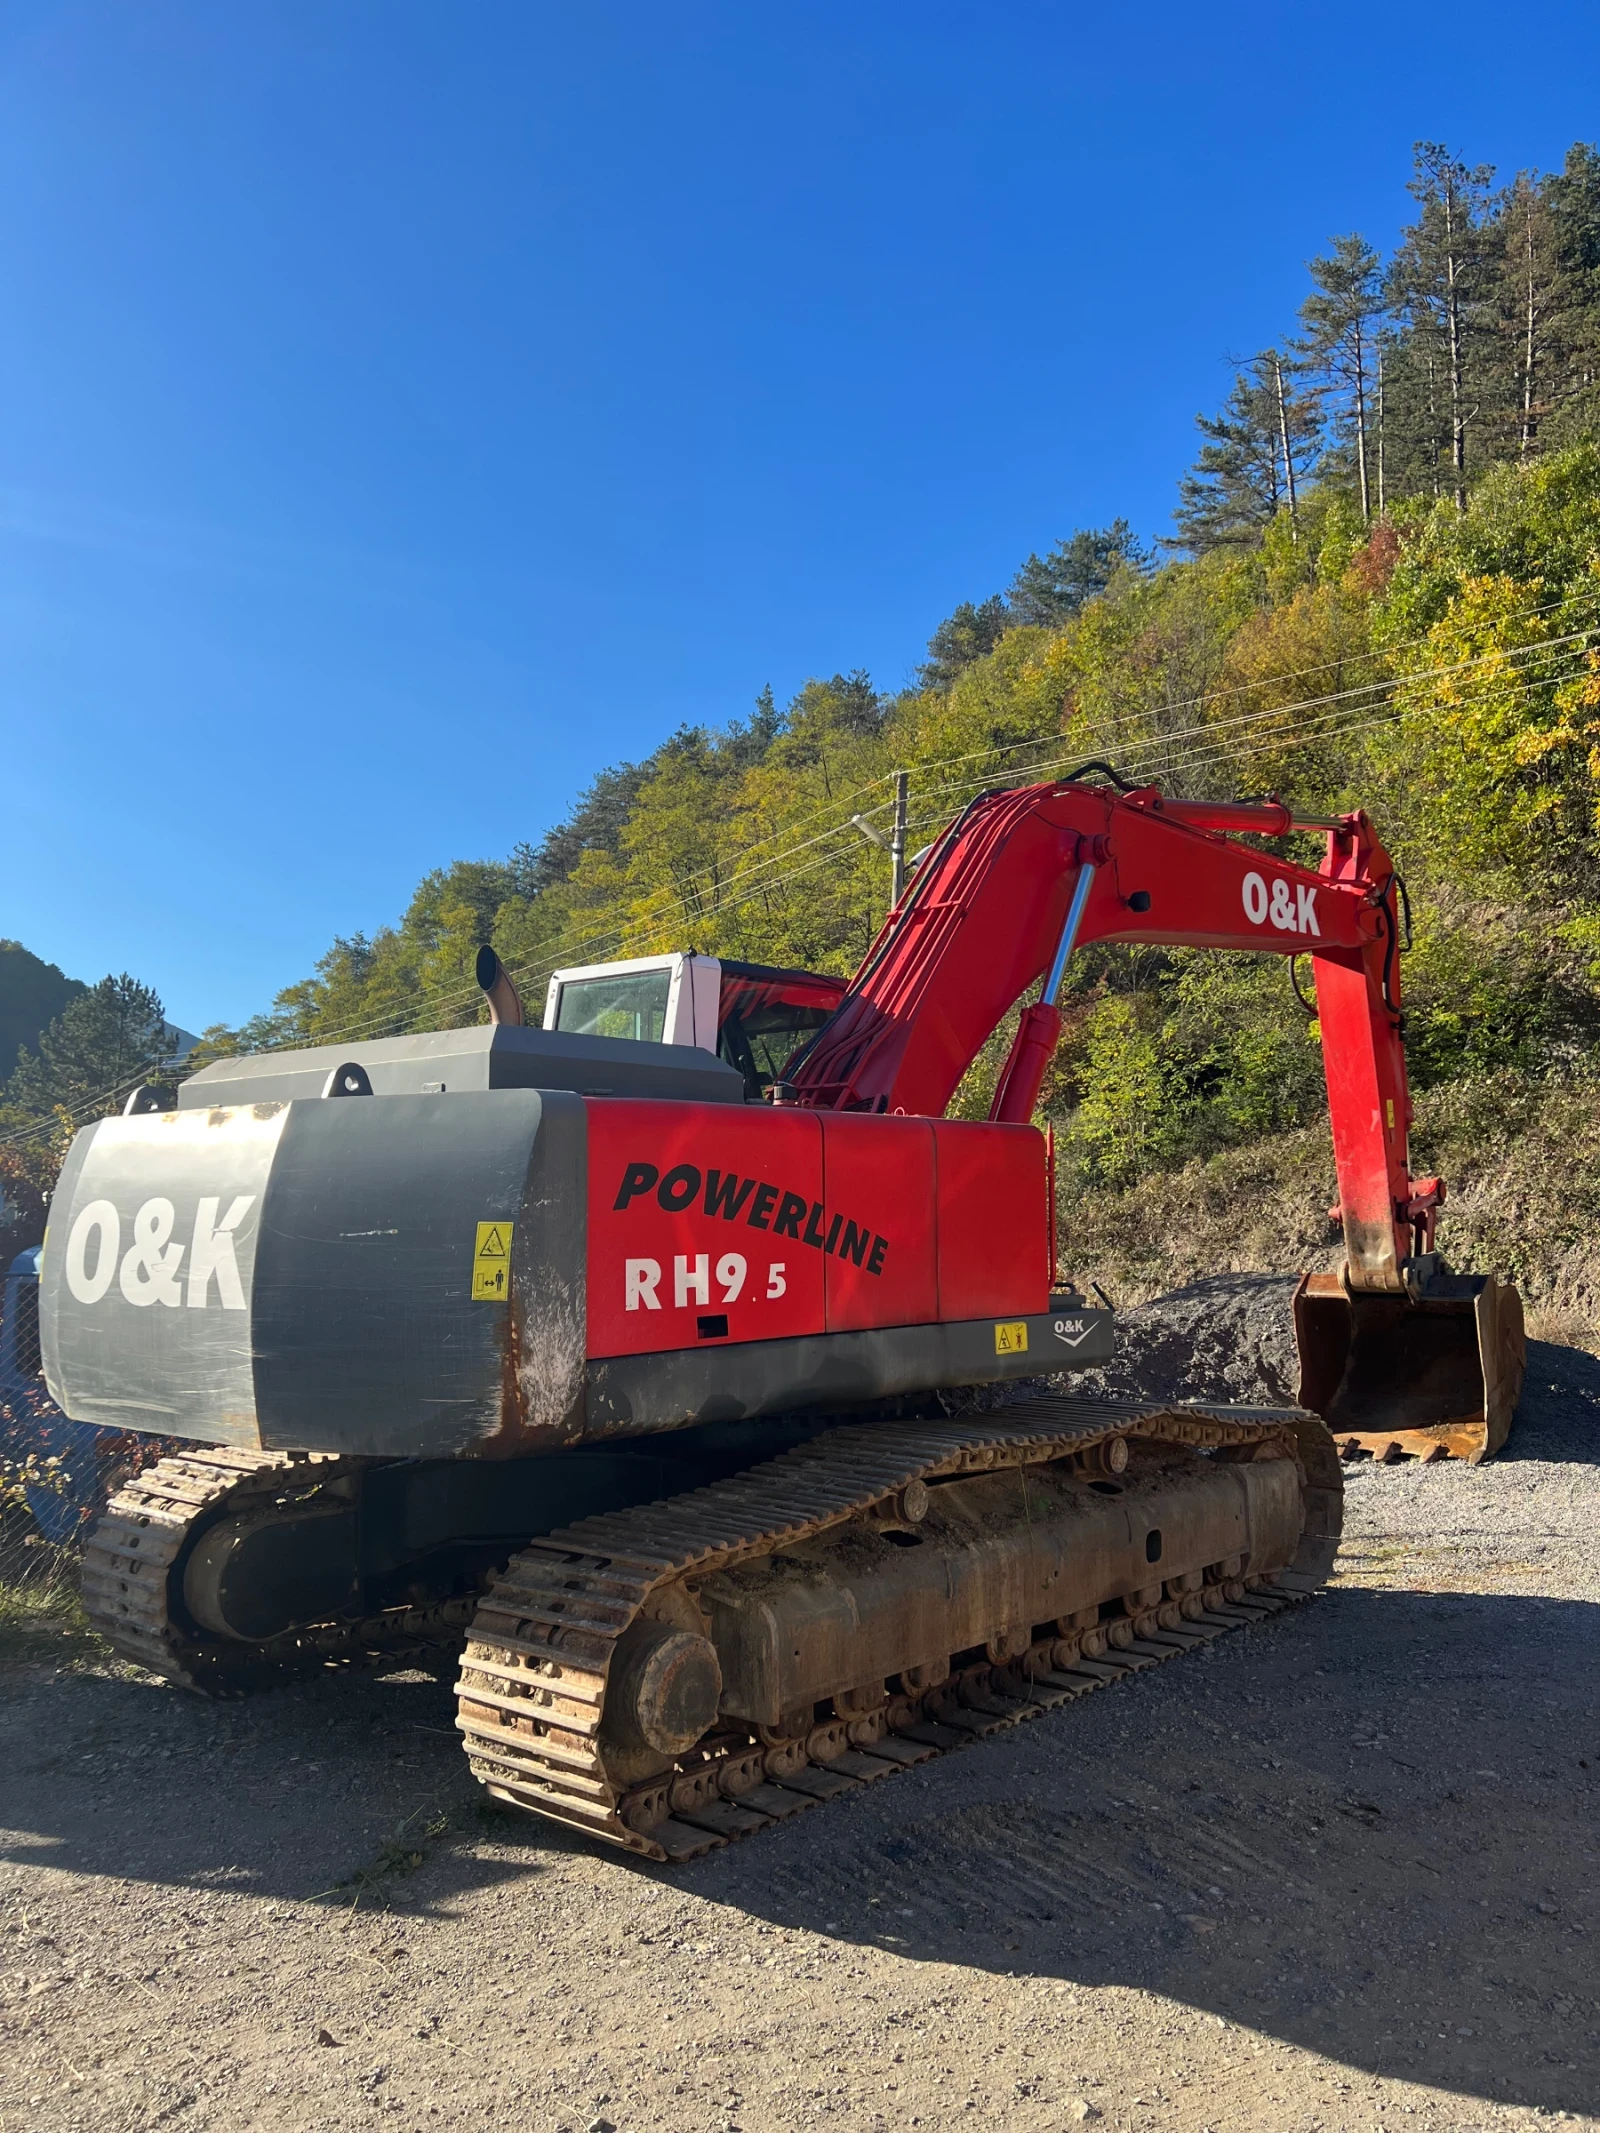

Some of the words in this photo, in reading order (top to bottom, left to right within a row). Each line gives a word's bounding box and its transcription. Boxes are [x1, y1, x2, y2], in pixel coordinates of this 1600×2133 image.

[1242, 872, 1321, 936] O&K
[65, 1195, 257, 1310] O&K
[613, 1162, 889, 1276] POWERLINE
[1054, 1319, 1084, 1333] O&K
